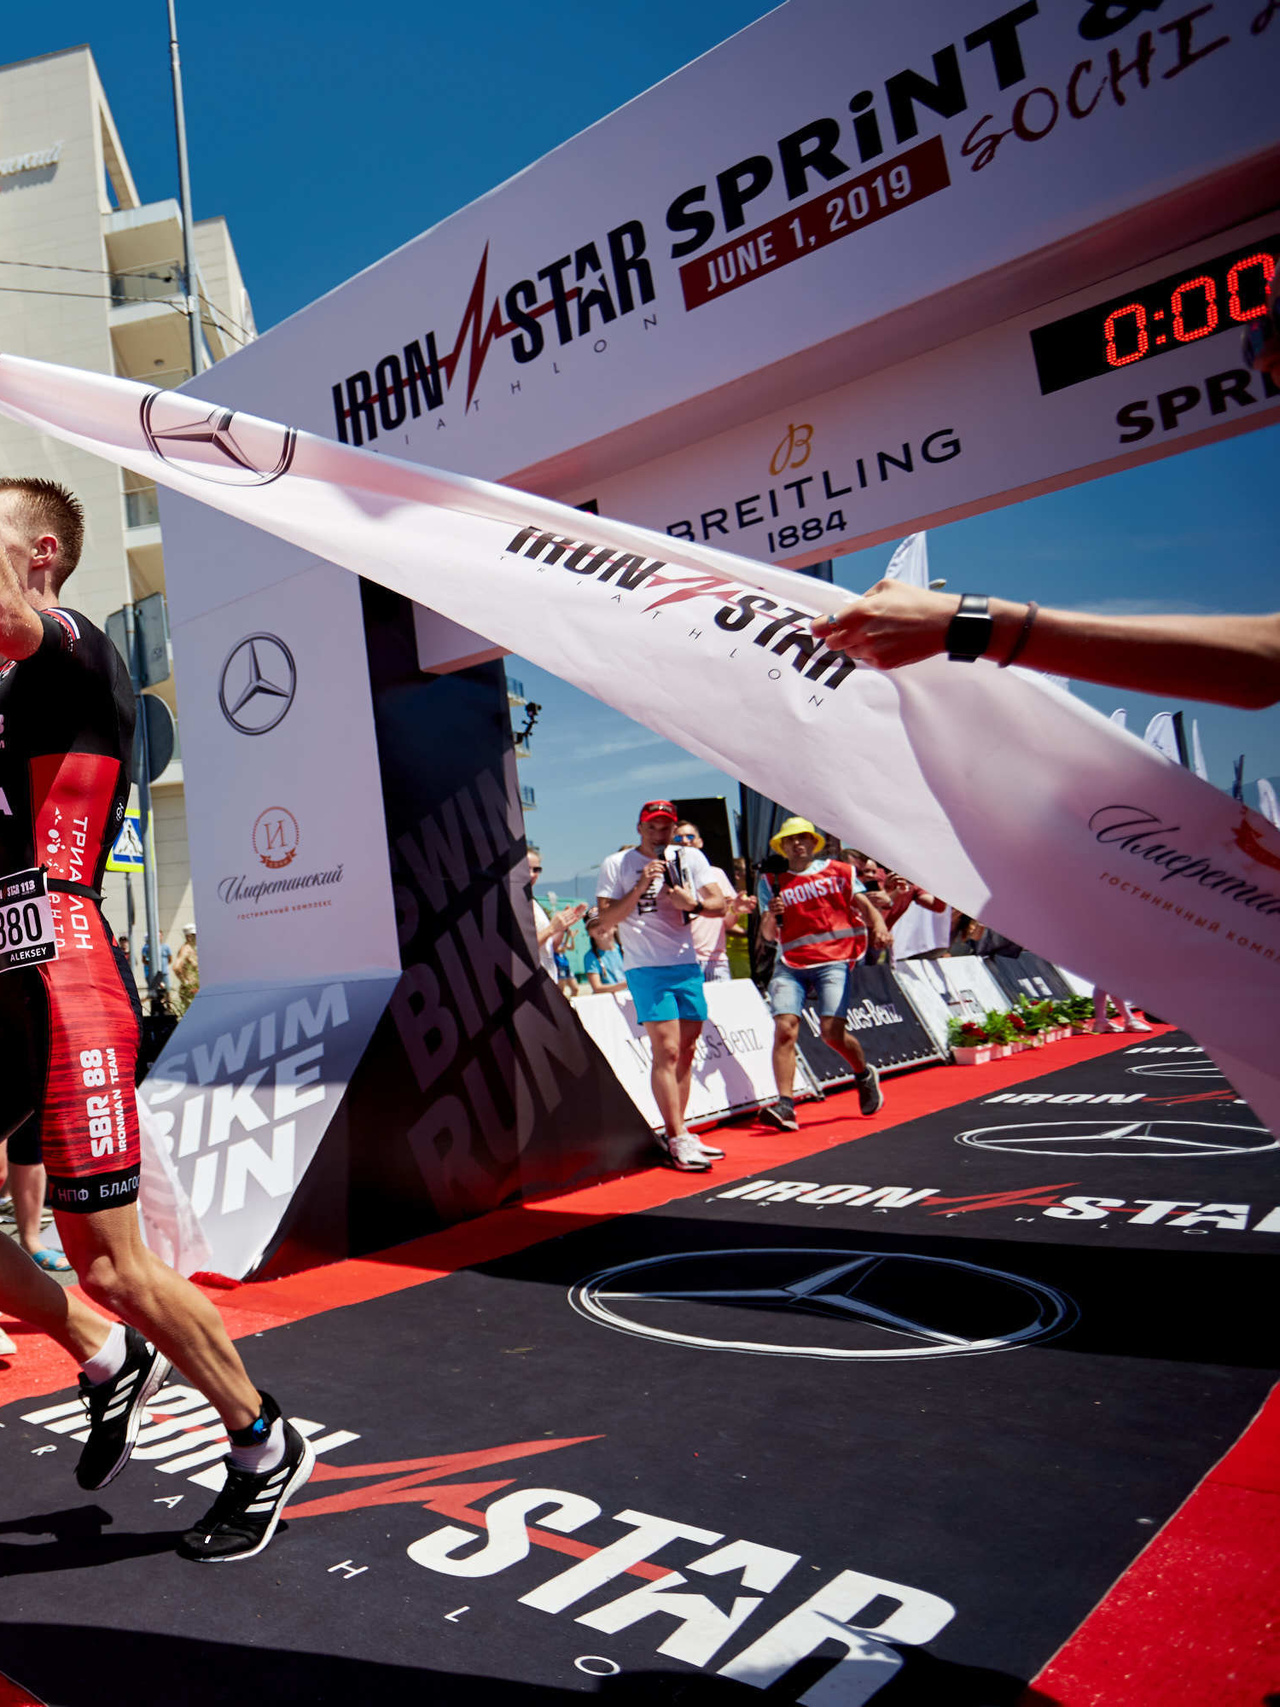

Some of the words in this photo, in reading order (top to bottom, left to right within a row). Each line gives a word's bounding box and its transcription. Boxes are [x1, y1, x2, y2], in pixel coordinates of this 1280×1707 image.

[960, 4, 1231, 172] SOCHI
[706, 231, 778, 293] JUNE
[788, 218, 818, 248] 1,
[826, 165, 912, 232] 2019
[332, 331, 444, 447] IRON
[505, 219, 657, 365] STAR
[404, 313, 658, 446] IATHLON
[666, 428, 962, 543] BREITLING
[768, 509, 847, 554] 1884
[68, 816, 94, 950] ТРИАЛОН
[10, 946, 47, 962] ALEKSEY
[80, 1049, 106, 1088] 88
[105, 1048, 119, 1085] TEAM
[149, 983, 350, 1106] SWIM
[86, 1095, 114, 1158] SBR
[113, 1089, 127, 1152] IRONMAN
[981, 1093, 1148, 1104] IRON
[174, 1120, 297, 1219] UN
[716, 1179, 941, 1208] IRON
[406, 1488, 957, 1707] STAR
